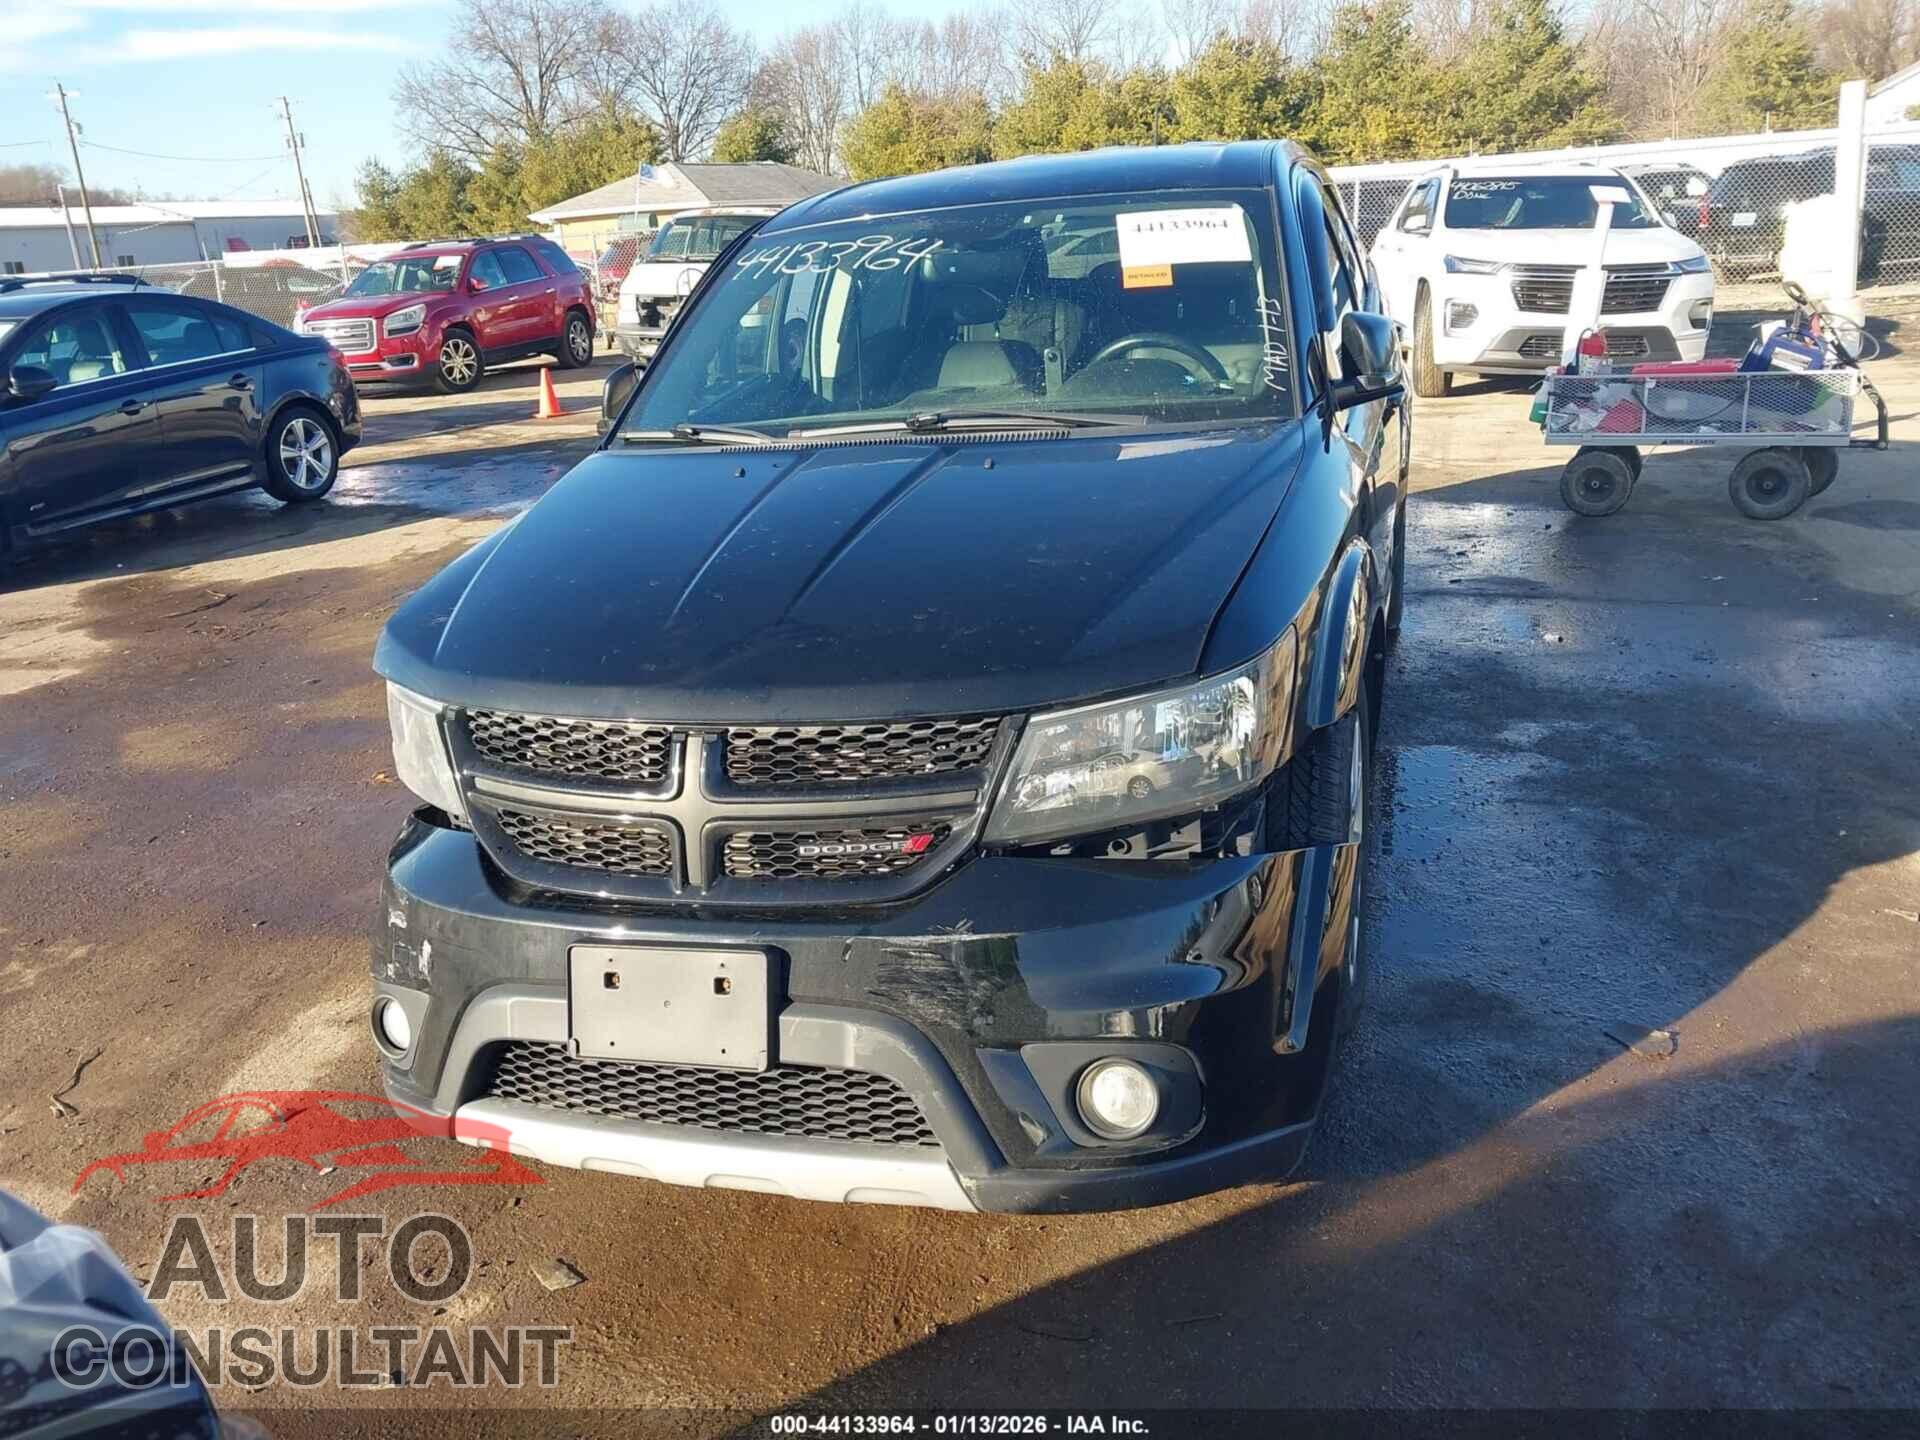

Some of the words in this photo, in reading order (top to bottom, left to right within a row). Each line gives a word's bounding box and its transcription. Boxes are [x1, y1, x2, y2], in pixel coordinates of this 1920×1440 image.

[1130, 219, 1229, 233] 44133964
[732, 235, 944, 281] 44133964
[799, 841, 912, 856] DODGE
